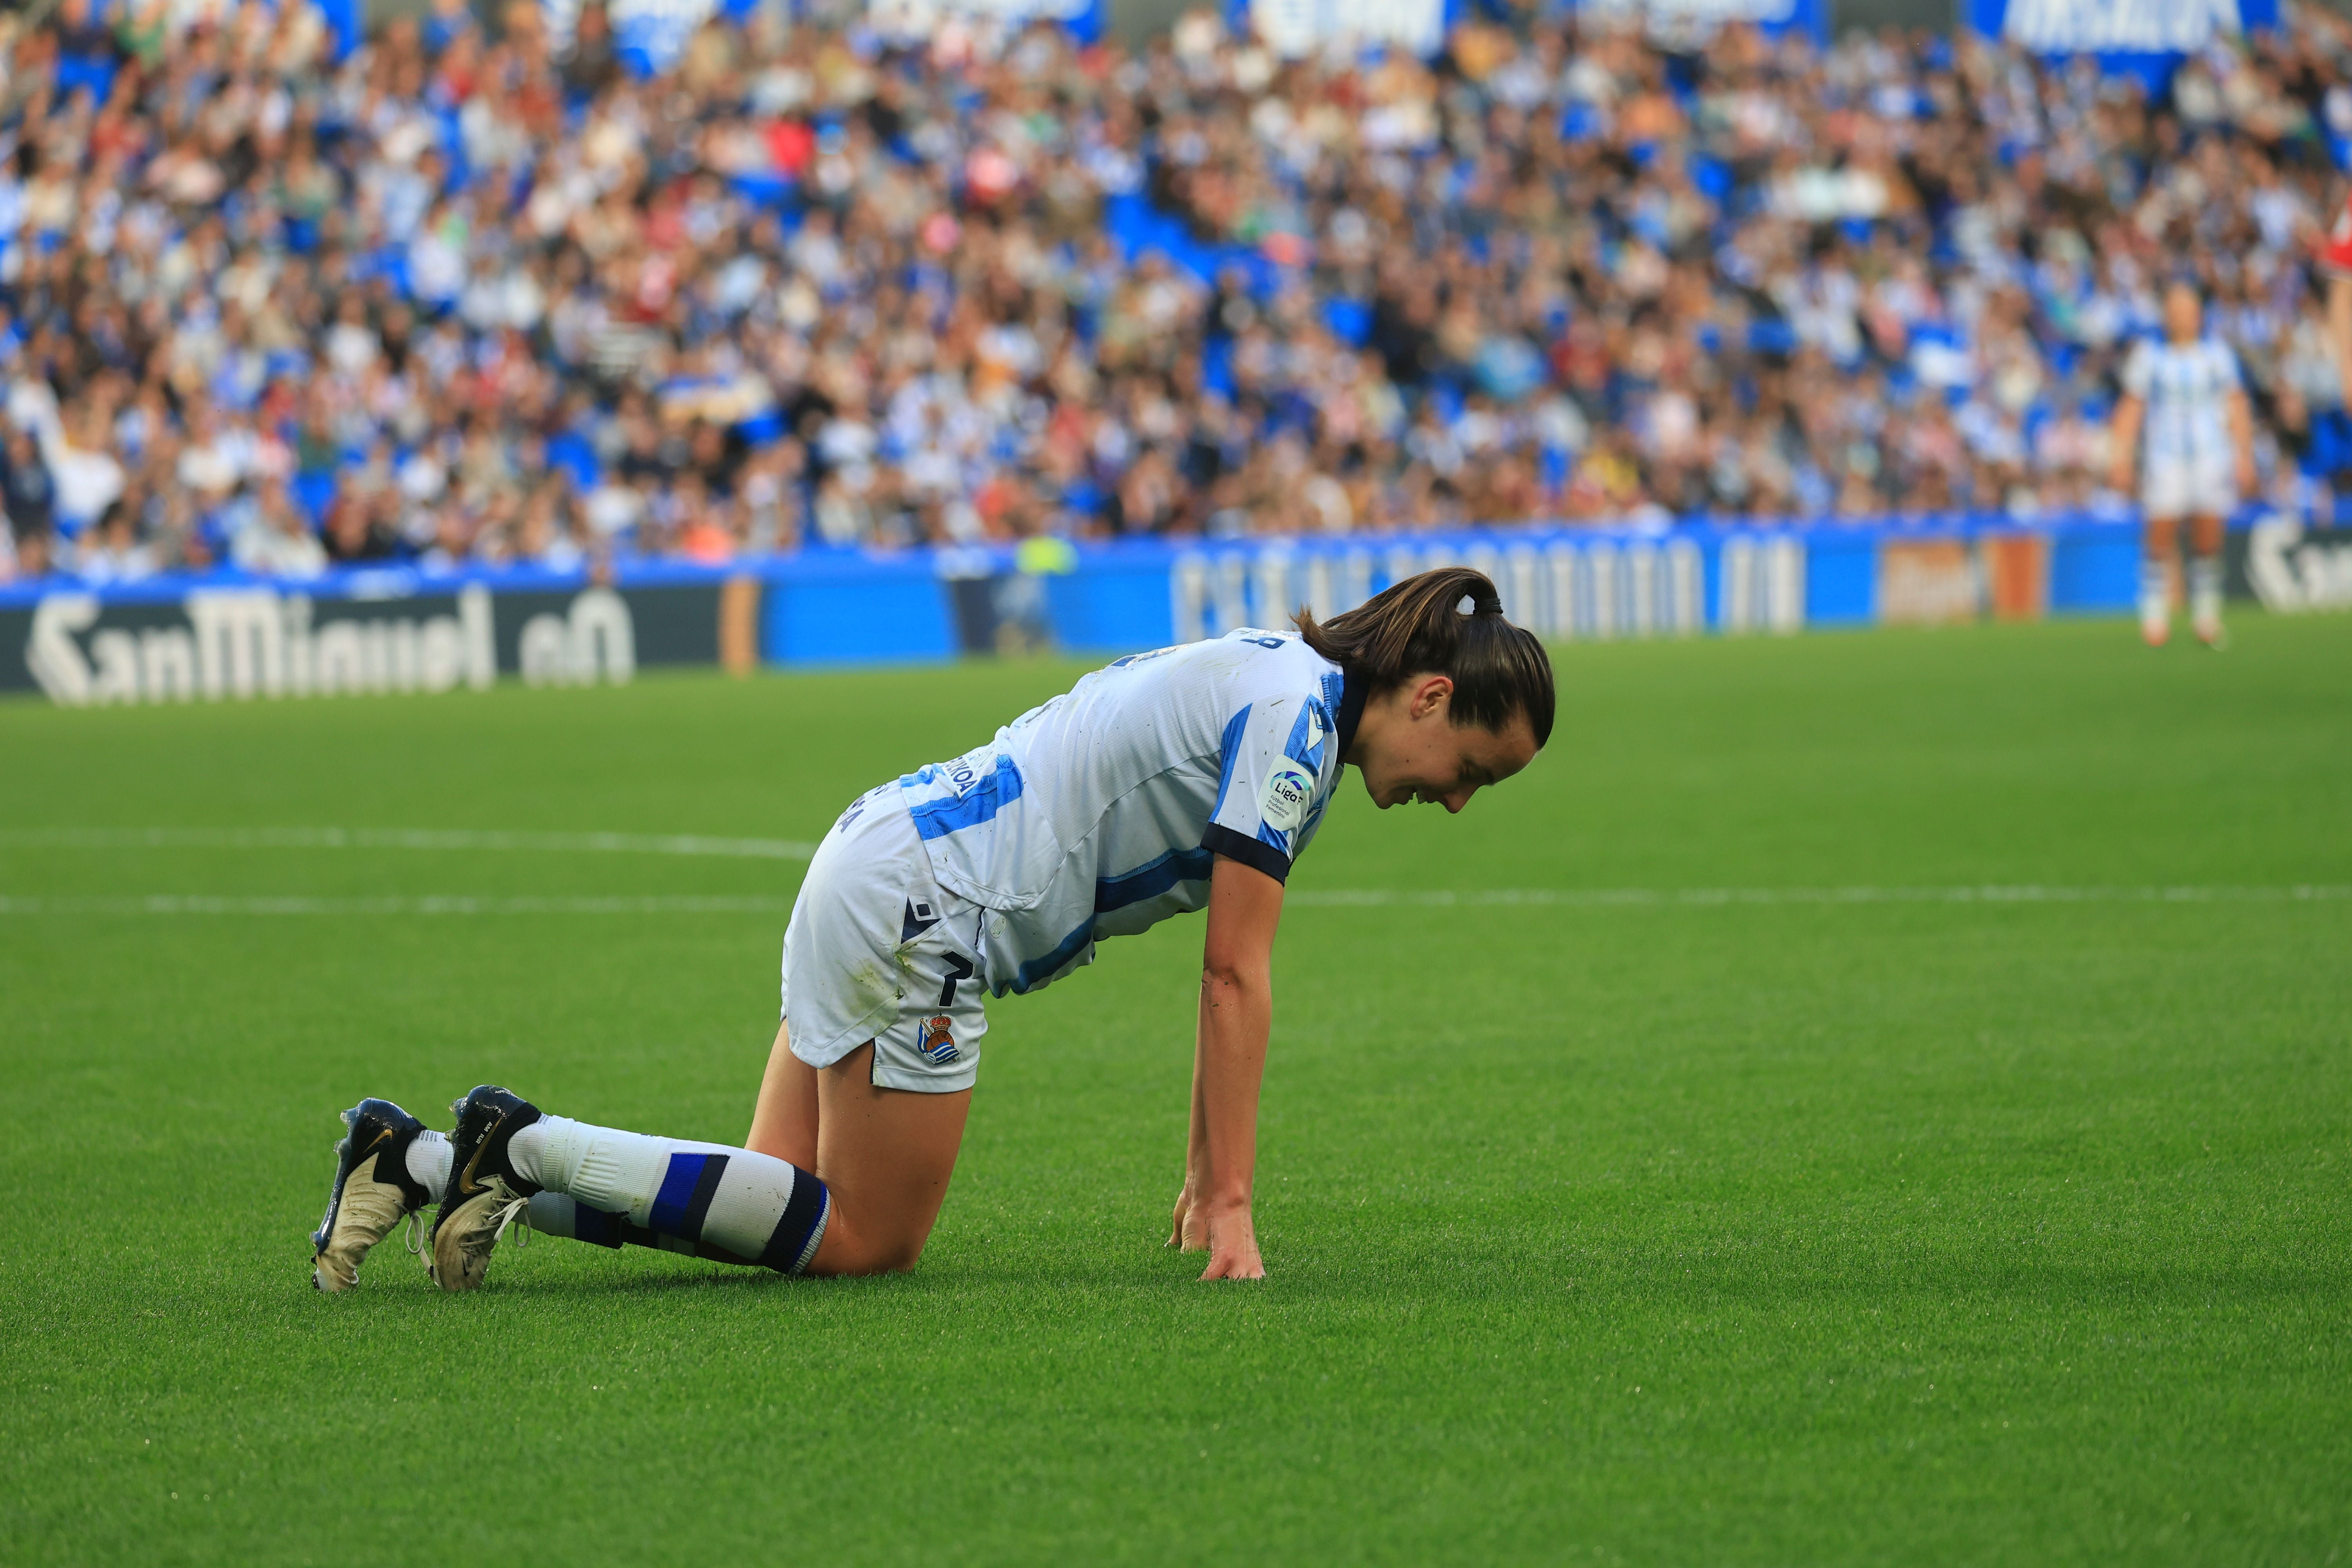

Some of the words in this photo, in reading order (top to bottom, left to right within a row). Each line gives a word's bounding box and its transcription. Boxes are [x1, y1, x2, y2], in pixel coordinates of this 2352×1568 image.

[945, 757, 978, 793] UZKOA
[1268, 800, 1290, 816] Profesional
[1270, 795, 1285, 806] Fútbol
[1265, 804, 1285, 819] Femenino
[938, 950, 974, 1007] 7
